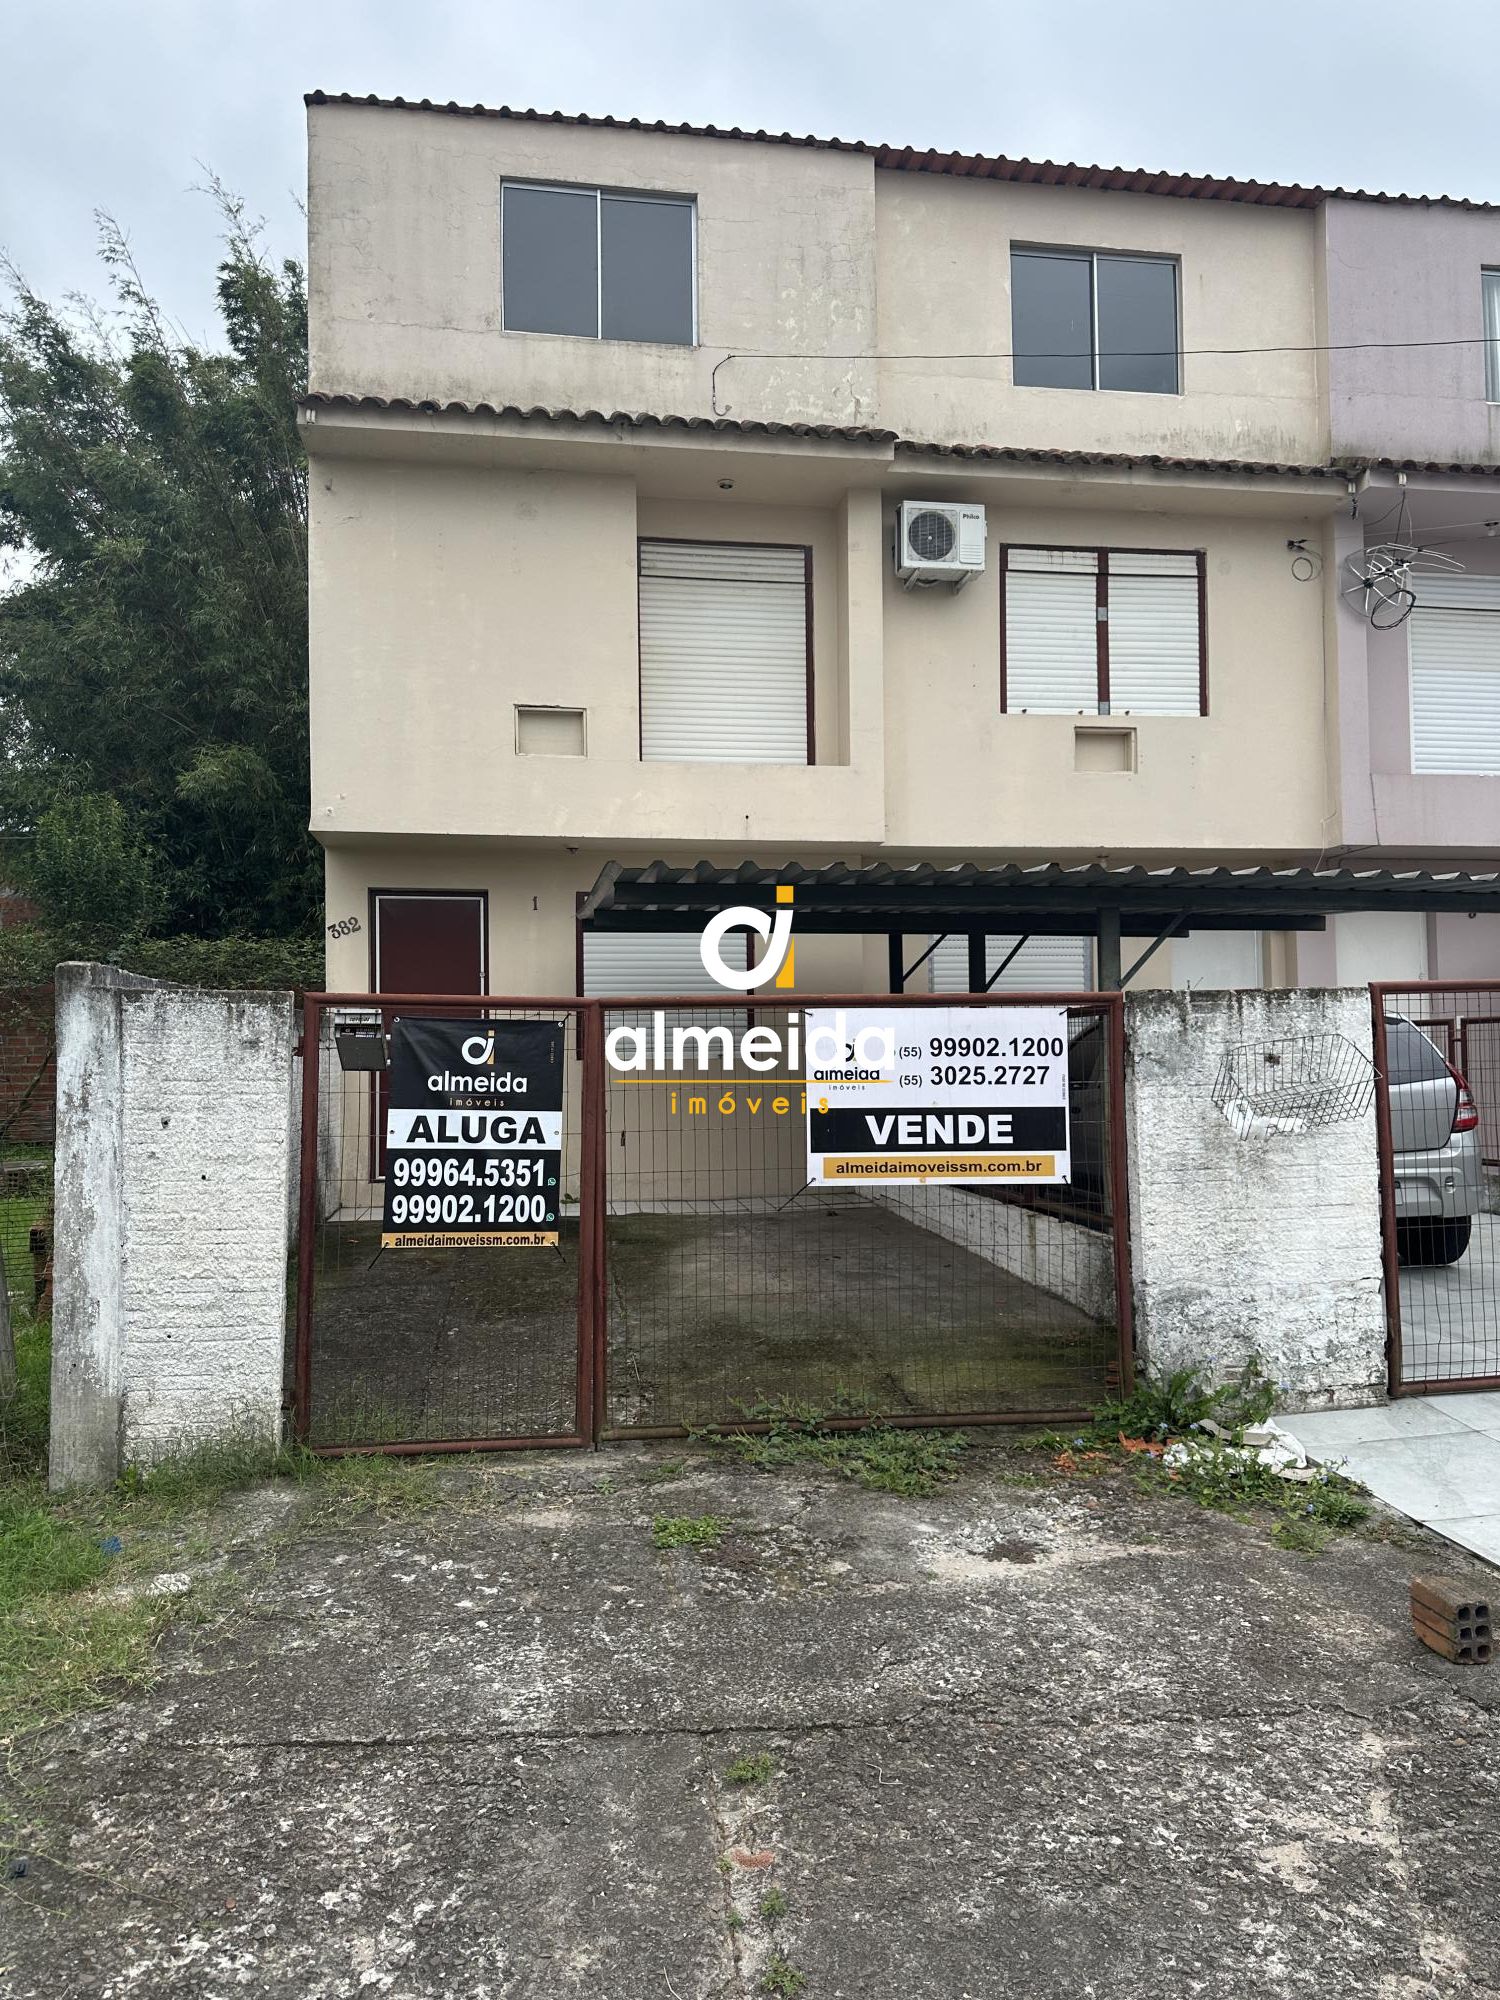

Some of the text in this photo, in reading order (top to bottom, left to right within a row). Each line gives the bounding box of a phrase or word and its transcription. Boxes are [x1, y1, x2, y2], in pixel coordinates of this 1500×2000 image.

[327, 916, 362, 940] 382
[898, 1037, 1064, 1060] (55) 99902.1200
[427, 1070, 528, 1093] almeida
[899, 1065, 1050, 1089] (55) 3025.2727
[449, 1097, 505, 1107] imóveis
[406, 1115, 546, 1144] ALUGA
[864, 1114, 1014, 1145] VENDE
[393, 1158, 545, 1187] 99964.5351
[835, 1160, 1043, 1175] almeidaimoveissm.com.br
[391, 1194, 546, 1223] 99902.1200
[394, 1232, 545, 1247] almeidaimoveissm.com.br
